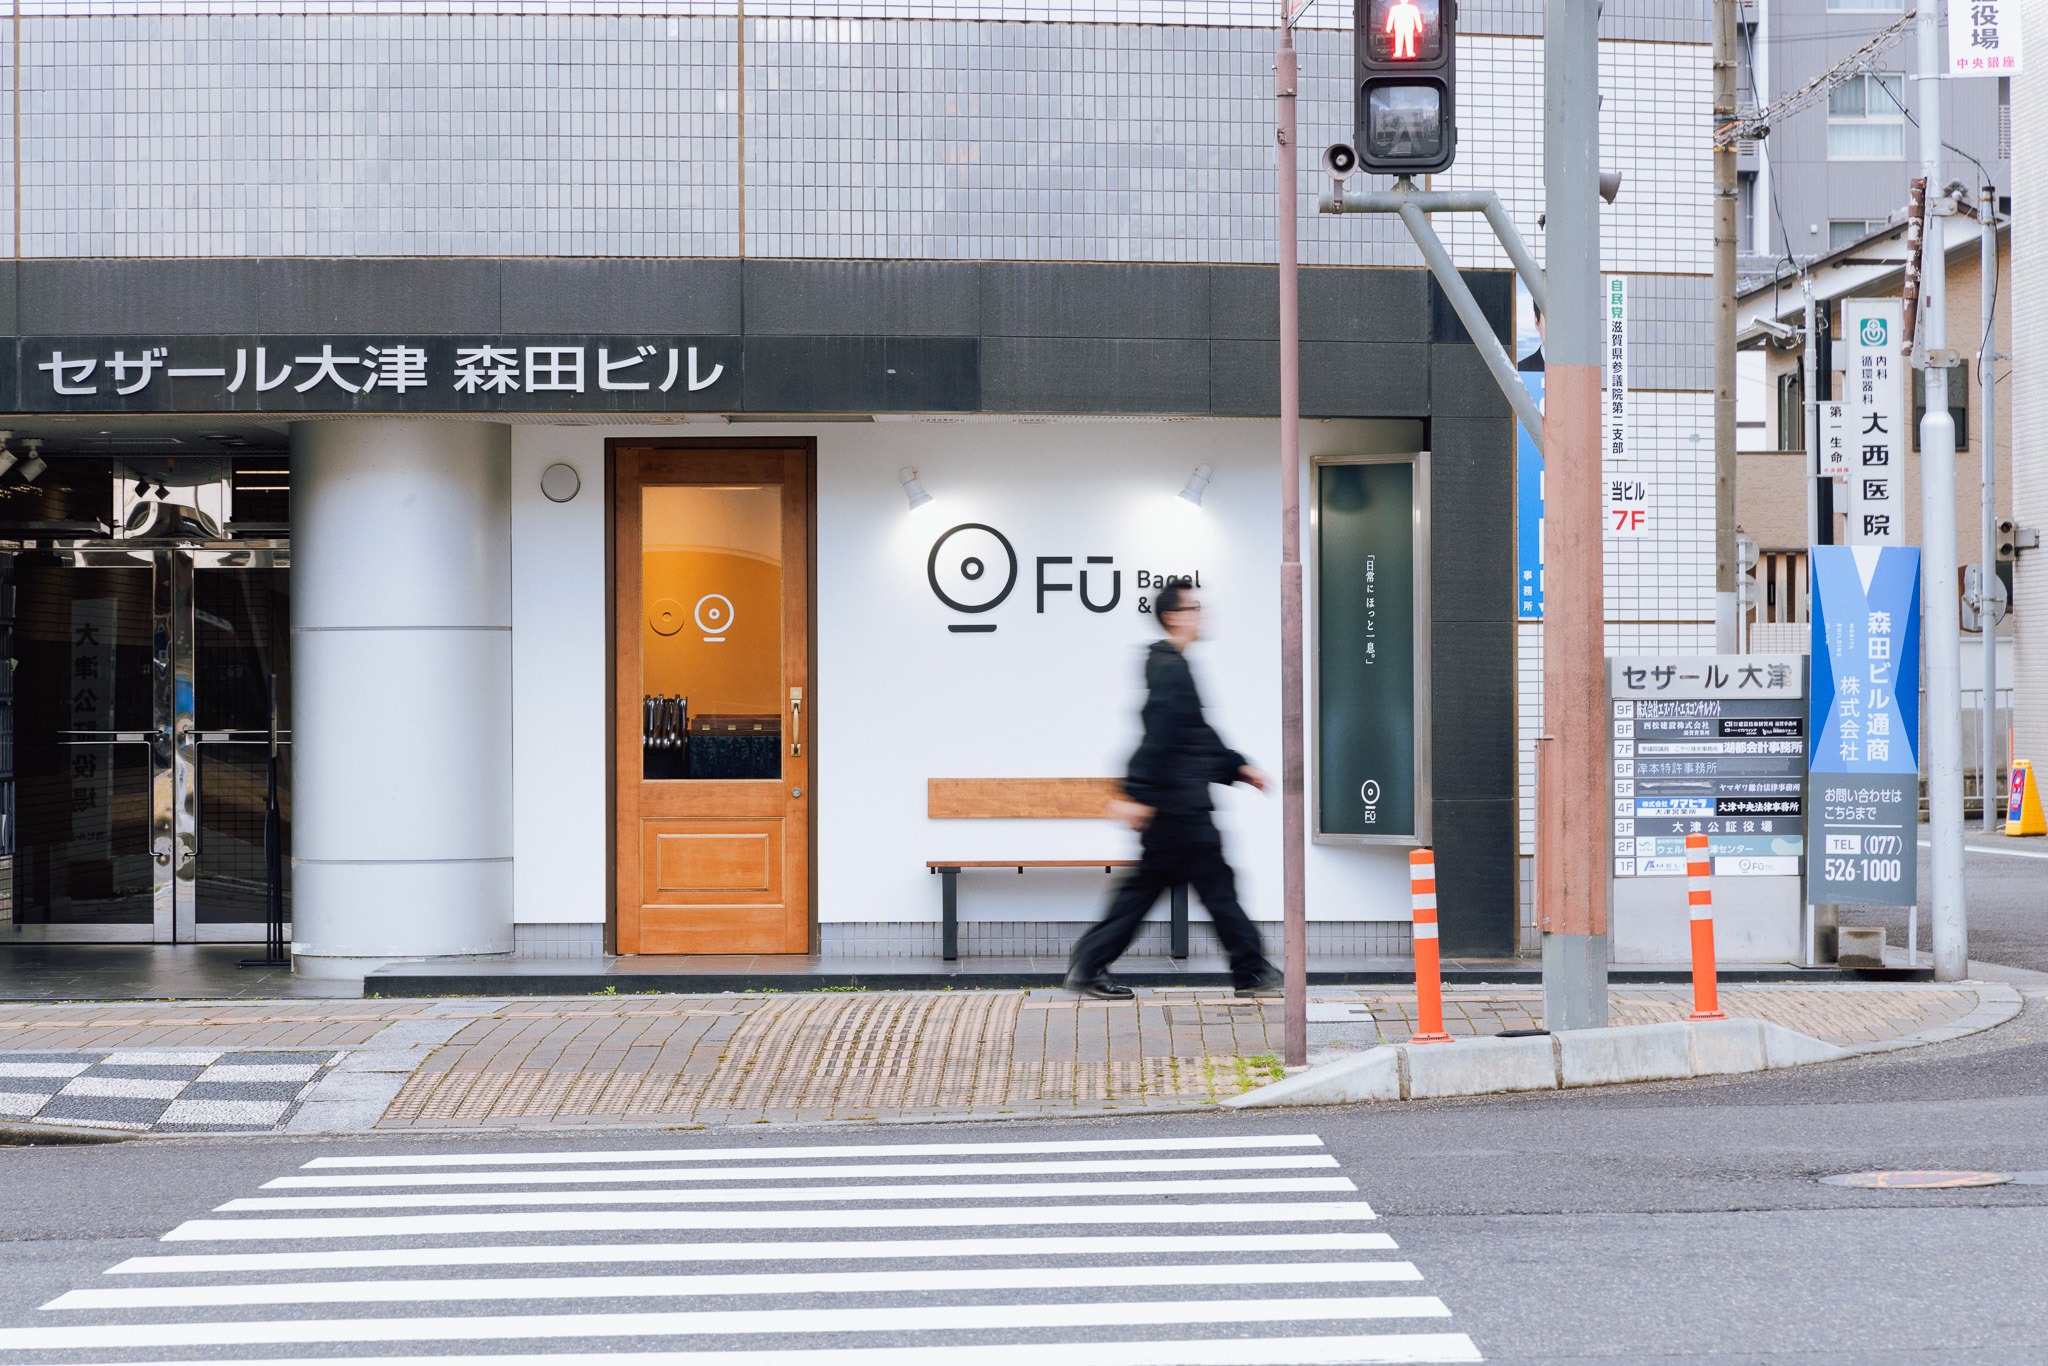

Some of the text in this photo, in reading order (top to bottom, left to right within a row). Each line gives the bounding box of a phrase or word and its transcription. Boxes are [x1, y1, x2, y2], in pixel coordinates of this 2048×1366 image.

[1971, 0, 1999, 50] 役場
[1957, 56, 2016, 69] 中央銀座
[38, 345, 724, 396] セザール大津 森田ビル
[1611, 280, 1624, 455] 自民党滋賀県参議院第二支部
[1876, 355, 1887, 380] 内科
[1862, 355, 1873, 405] 循環器科
[1830, 405, 1843, 463] 第一生命
[1862, 412, 1889, 536] 大西医院
[1612, 481, 1645, 502] 当ビル
[1612, 511, 1645, 531] 7F
[1523, 570, 1533, 612] 事務所
[1867, 611, 1891, 762] 森田ビル通商
[1617, 705, 1632, 715] 9F
[1839, 675, 1861, 762] 株式会社
[1617, 724, 1632, 734] 8F
[1644, 721, 1710, 730] 西松建設株式会社
[1617, 744, 1632, 754] 7F
[1722, 741, 1803, 755] 湖都会計事務所
[1617, 761, 1717, 774] 6F 岸本特許事務所
[1617, 783, 1633, 793] 5F
[1824, 788, 1902, 805] お問い合わせは
[1617, 803, 1633, 813] 4F
[1719, 802, 1800, 813] 大津中央法律事務所
[1824, 806, 1877, 821] こちらまで
[1617, 821, 1774, 833] 3F 大津公証役場
[1617, 842, 1633, 852] 2F
[1833, 835, 1902, 856] TEL (077)
[1620, 862, 1633, 872] 1F
[1824, 858, 1901, 883] 526-1000
